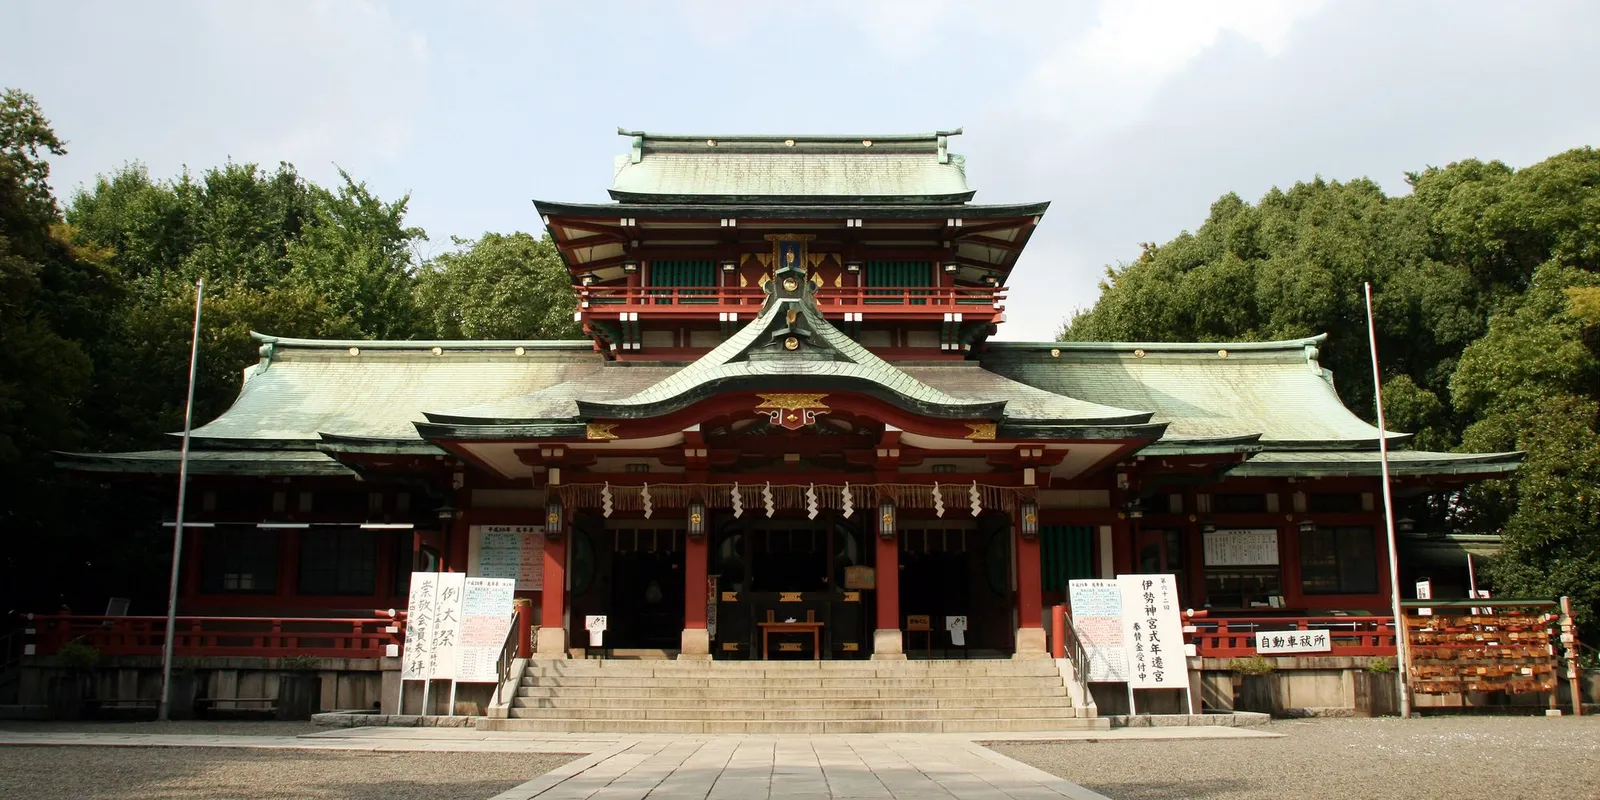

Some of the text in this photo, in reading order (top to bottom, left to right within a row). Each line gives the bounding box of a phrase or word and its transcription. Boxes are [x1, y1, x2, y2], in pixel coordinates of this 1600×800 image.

[410, 579, 434, 677] 崇敬会員参拝
[438, 586, 460, 647] 例大祭
[1141, 579, 1165, 683] 伊勢神宮式年遷宮
[1260, 634, 1326, 649] 自動車祓所
[1132, 622, 1147, 682] 奉賛金受付中
